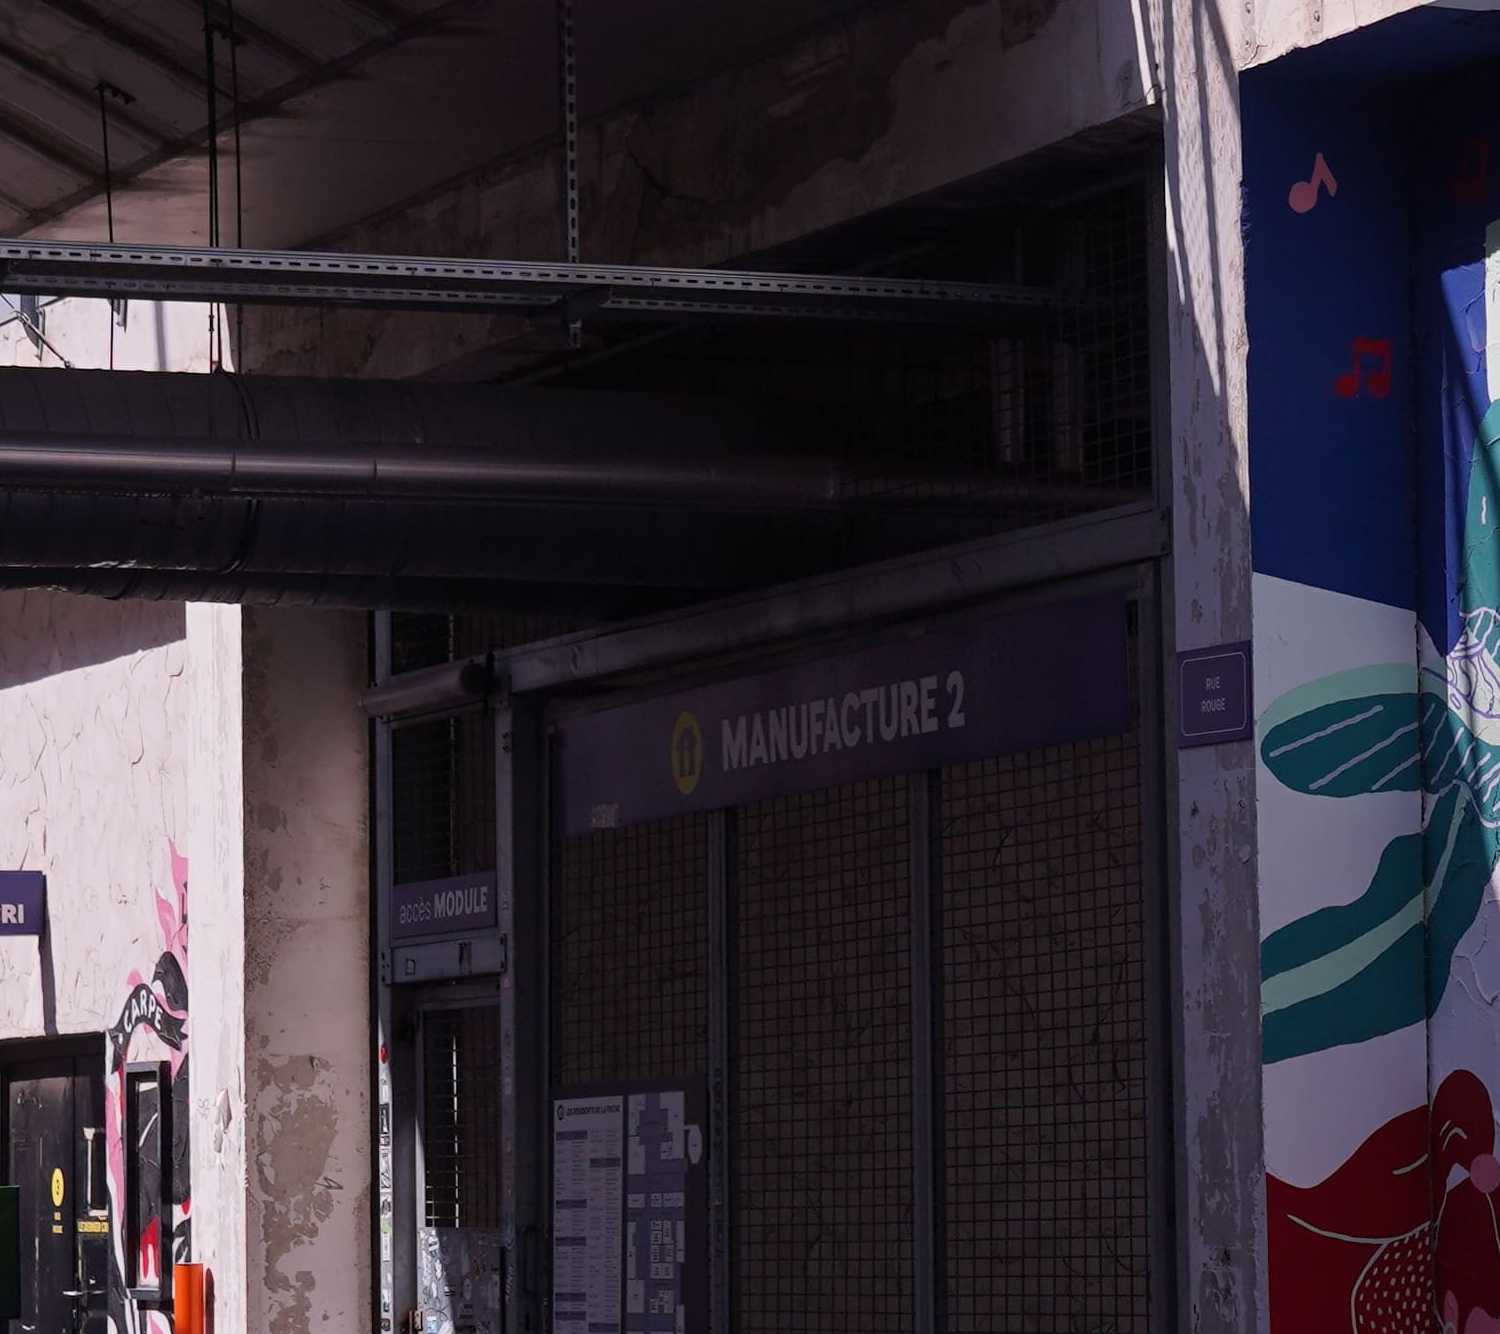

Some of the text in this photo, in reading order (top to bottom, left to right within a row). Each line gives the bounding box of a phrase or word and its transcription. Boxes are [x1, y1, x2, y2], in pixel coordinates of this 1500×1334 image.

[1205, 676, 1220, 691] RUE
[721, 670, 965, 771] MANUFACTURE 2
[1201, 697, 1226, 712] ROUGE
[399, 886, 488, 924] accès MODULE
[123, 989, 163, 1033] CARPE
